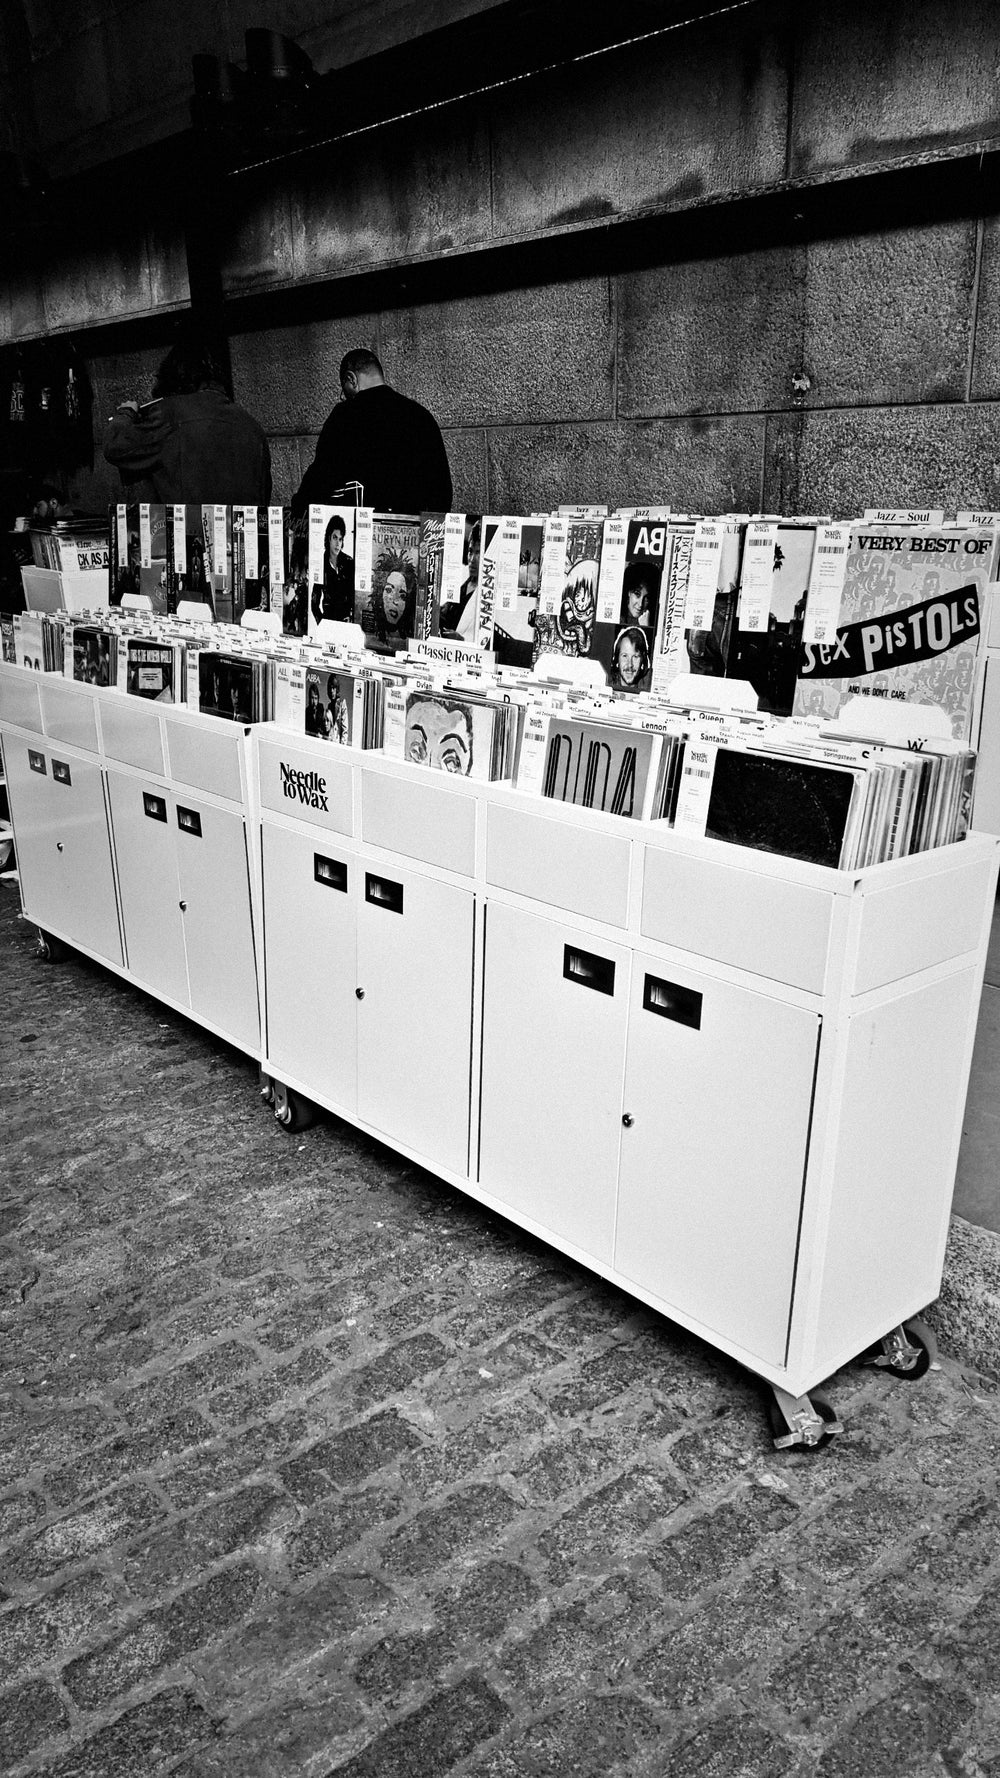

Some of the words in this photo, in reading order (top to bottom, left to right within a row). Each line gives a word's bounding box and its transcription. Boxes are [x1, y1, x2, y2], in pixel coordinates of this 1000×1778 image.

[635, 509, 650, 517] Jazz
[874, 512, 896, 521] Jazz
[907, 512, 930, 521] Soul
[968, 514, 994, 524] Jazz
[372, 533, 401, 546] AURYN
[403, 535, 419, 548] HIL
[858, 535, 906, 551] VERY
[909, 537, 960, 553] BEST
[964, 538, 992, 554] OF
[91, 553, 102, 566] AS
[417, 644, 453, 662] Classic
[455, 649, 483, 664] Rock
[306, 673, 321, 685] ABBA
[358, 669, 374, 677] ABBA
[416, 680, 433, 690] Dylan
[848, 685, 860, 695] AND
[861, 687, 871, 697] WE
[891, 688, 907, 699] CARE
[698, 712, 725, 724] Queen
[641, 721, 667, 732] Lennon
[700, 732, 728, 744] Santana
[824, 751, 857, 762] Springsteen
[280, 762, 327, 793] Needle
[283, 780, 297, 799] to
[297, 783, 329, 812] Wax
